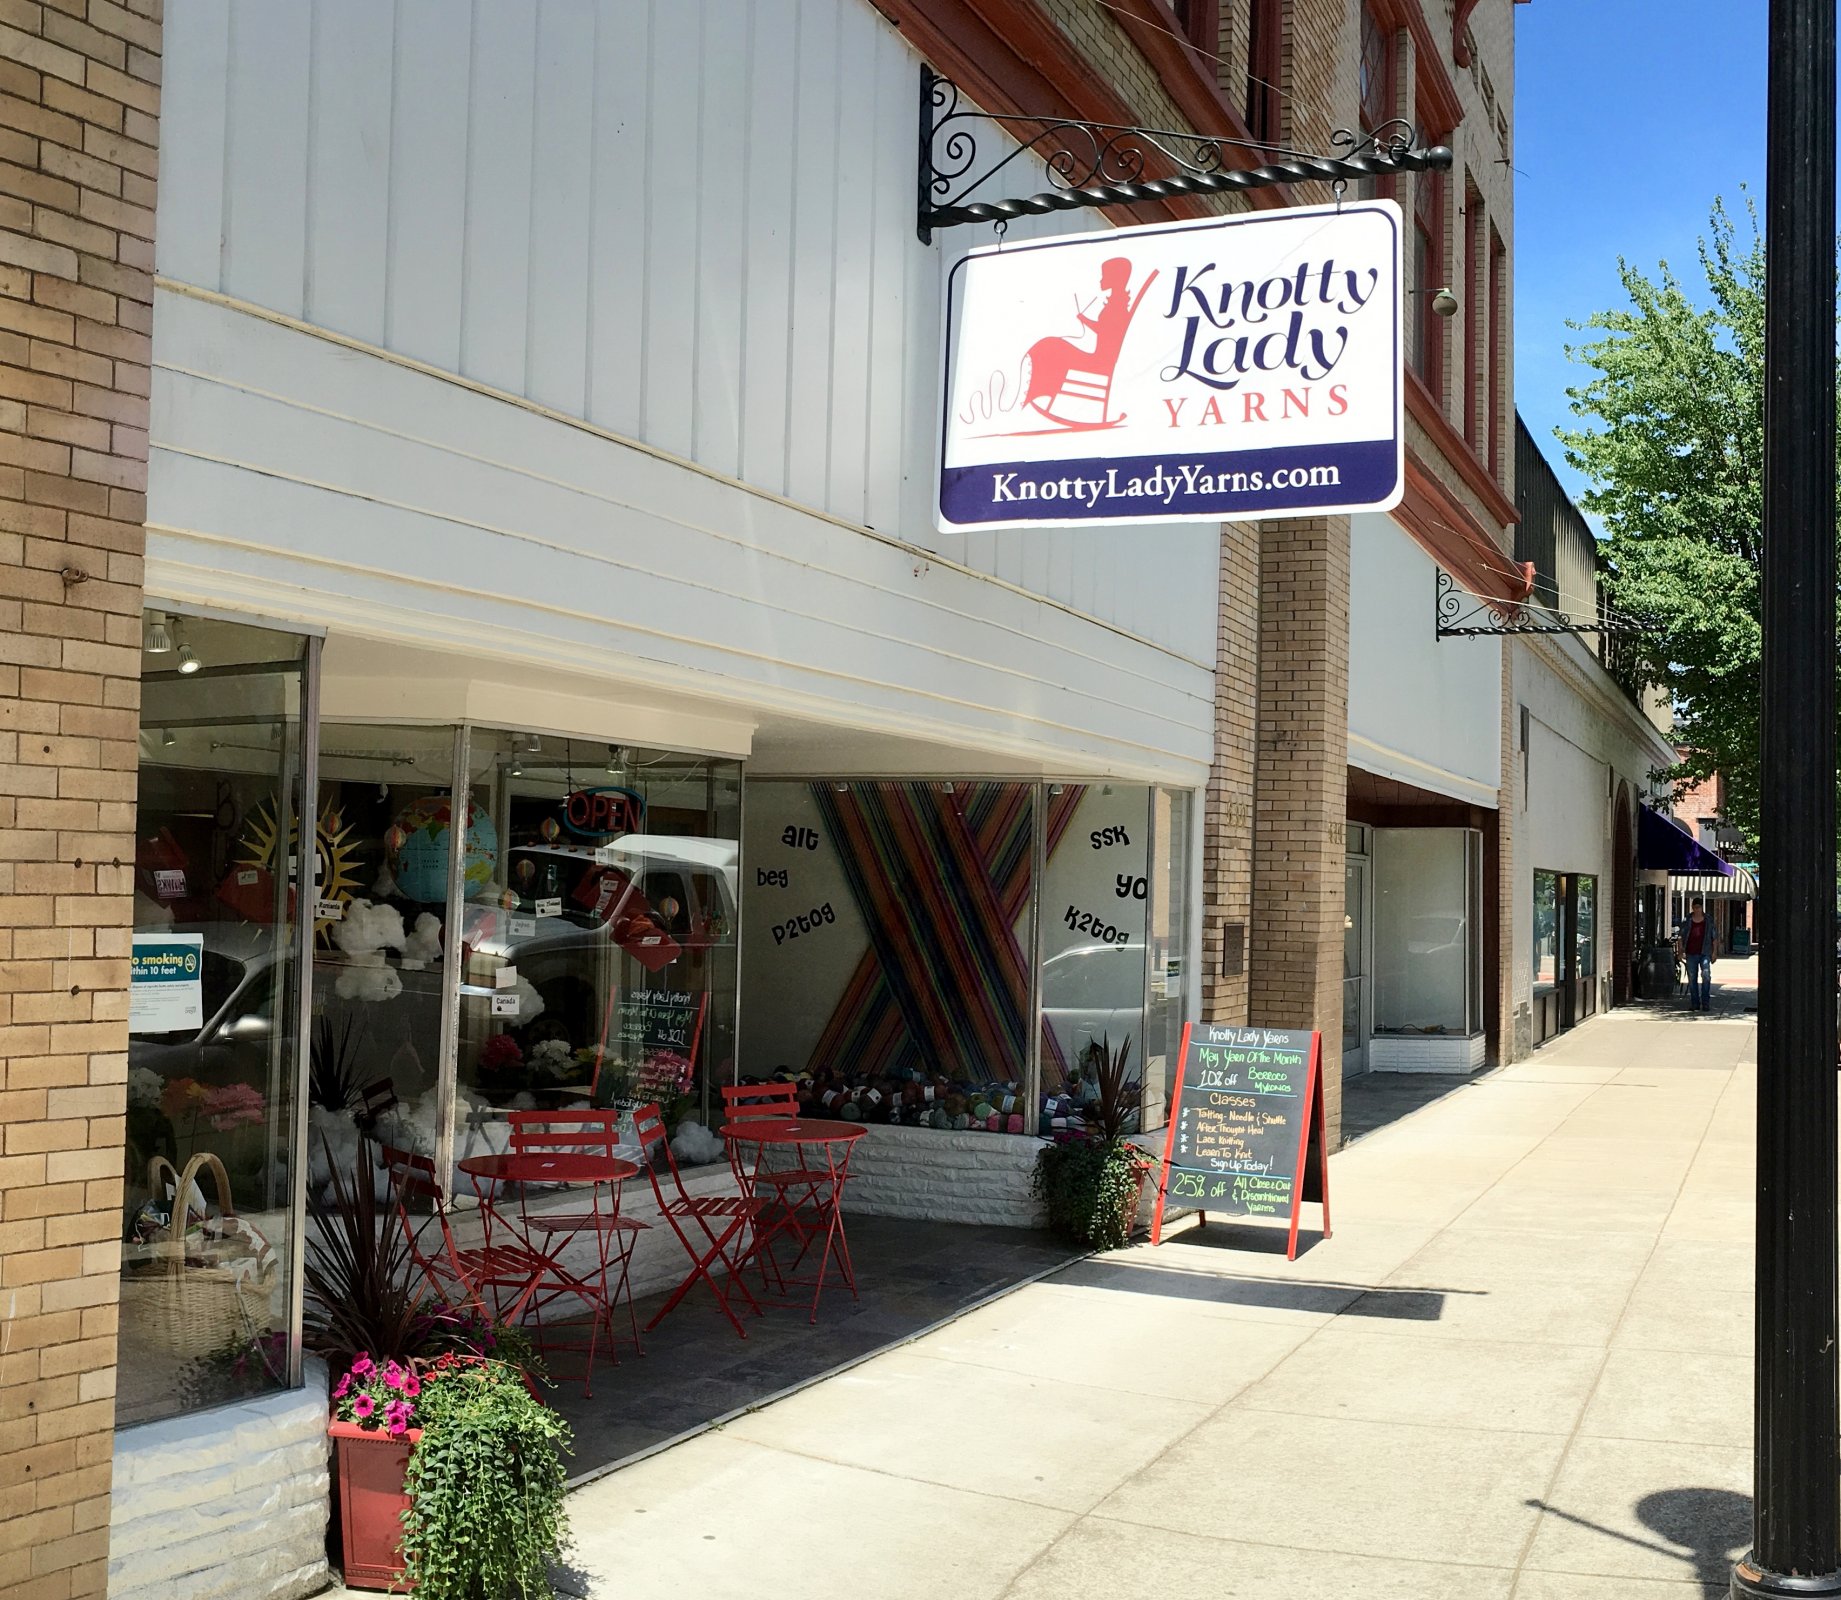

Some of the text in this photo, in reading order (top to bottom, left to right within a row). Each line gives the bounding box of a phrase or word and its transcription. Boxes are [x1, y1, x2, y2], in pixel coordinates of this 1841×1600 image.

[1162, 259, 1378, 329] Knotty
[1160, 311, 1348, 391] Lady
[1162, 384, 1348, 428] YARNS
[992, 464, 1342, 509] KnottyLadyYarns.com
[567, 792, 641, 832] OPEN
[781, 825, 819, 851] alt
[757, 867, 789, 888] beg
[771, 902, 836, 946] p2tog
[142, 953, 183, 967] smoking
[150, 966, 159, 975] 10
[161, 966, 177, 975] feet
[496, 997, 516, 1005] Canada
[1237, 1028, 1260, 1047] Lady
[1199, 1048, 1219, 1068] May
[1273, 1051, 1302, 1065] Month
[1199, 1069, 1239, 1088] 10% off
[1209, 1092, 1256, 1107] Classes
[1229, 1110, 1255, 1122] Needle
[1196, 1133, 1216, 1144] Lace
[1234, 1149, 1253, 1159] Knit
[1210, 1155, 1274, 1175] Sign Up Today!
[1172, 1172, 1227, 1197] 25% off
[1233, 1176, 1248, 1189] All
